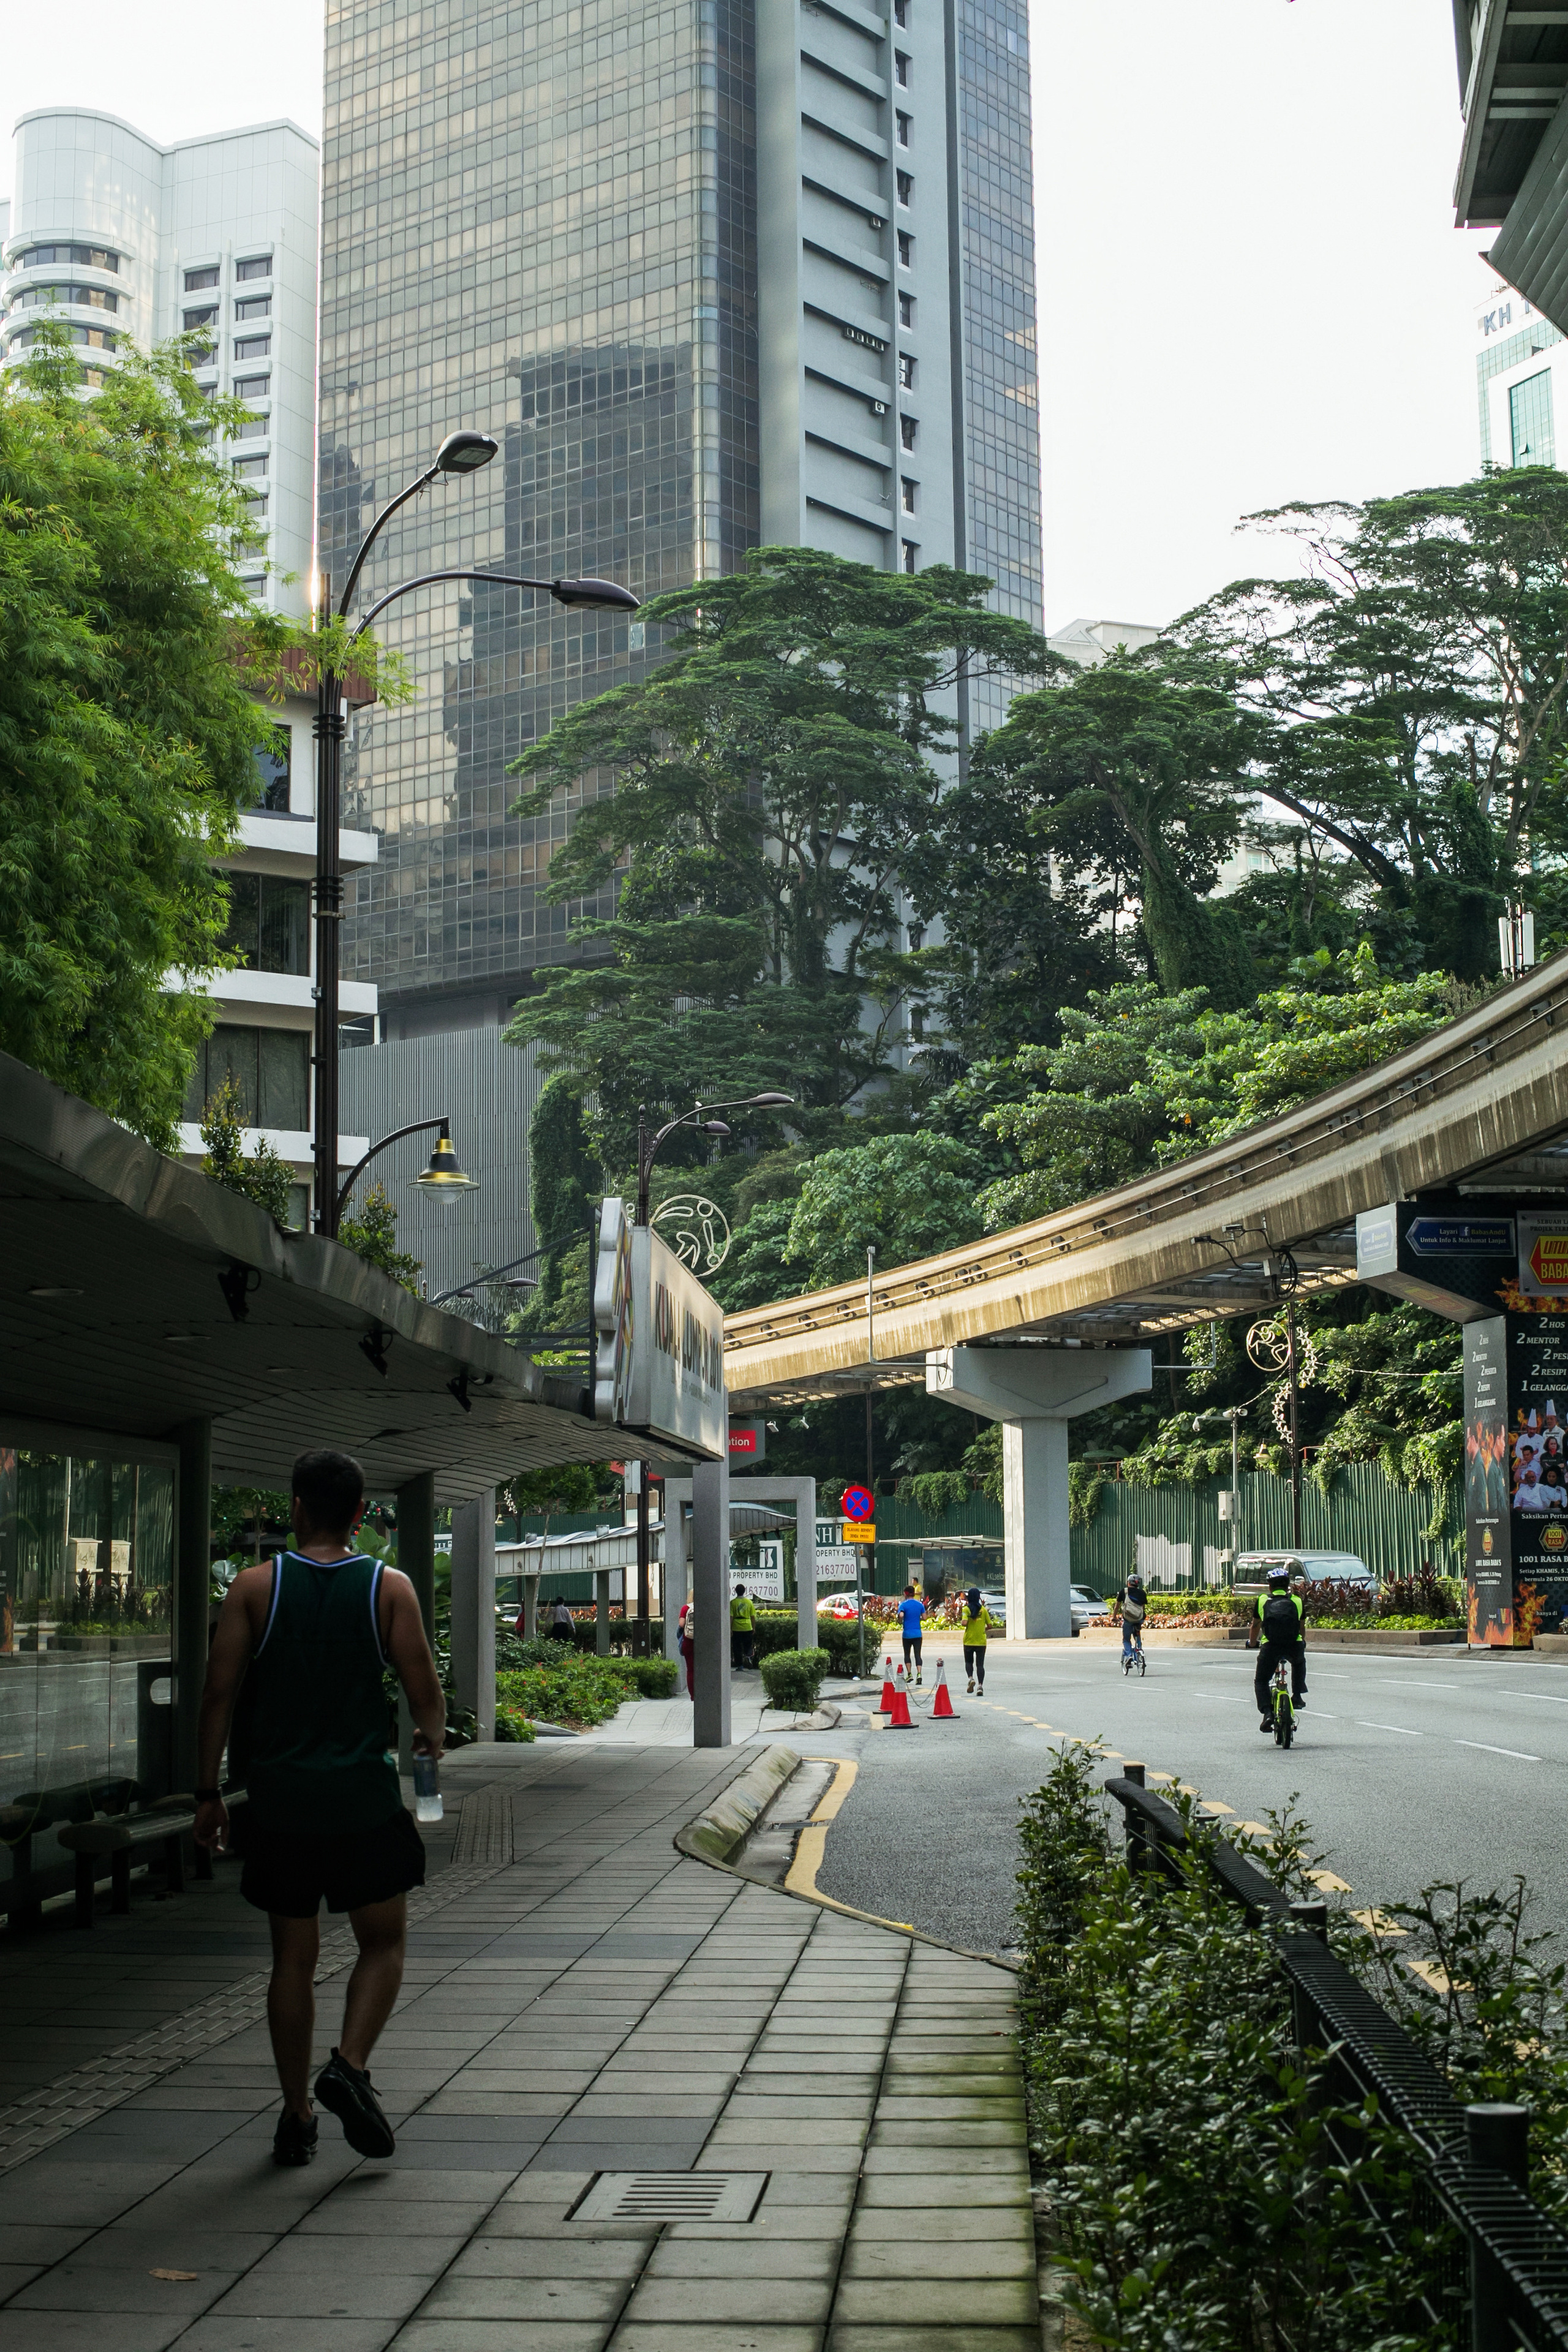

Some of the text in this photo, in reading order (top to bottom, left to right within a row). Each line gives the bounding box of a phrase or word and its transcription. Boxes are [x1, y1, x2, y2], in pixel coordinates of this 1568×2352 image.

[1483, 303, 1511, 336] KH
[1539, 1317, 1548, 1328] 2
[1517, 1333, 1525, 1344] 2
[682, 1306, 709, 1385] LUMPUR
[1543, 1349, 1551, 1359] 2
[1531, 1364, 1540, 1375] 2
[1521, 1380, 1528, 1391] 1
